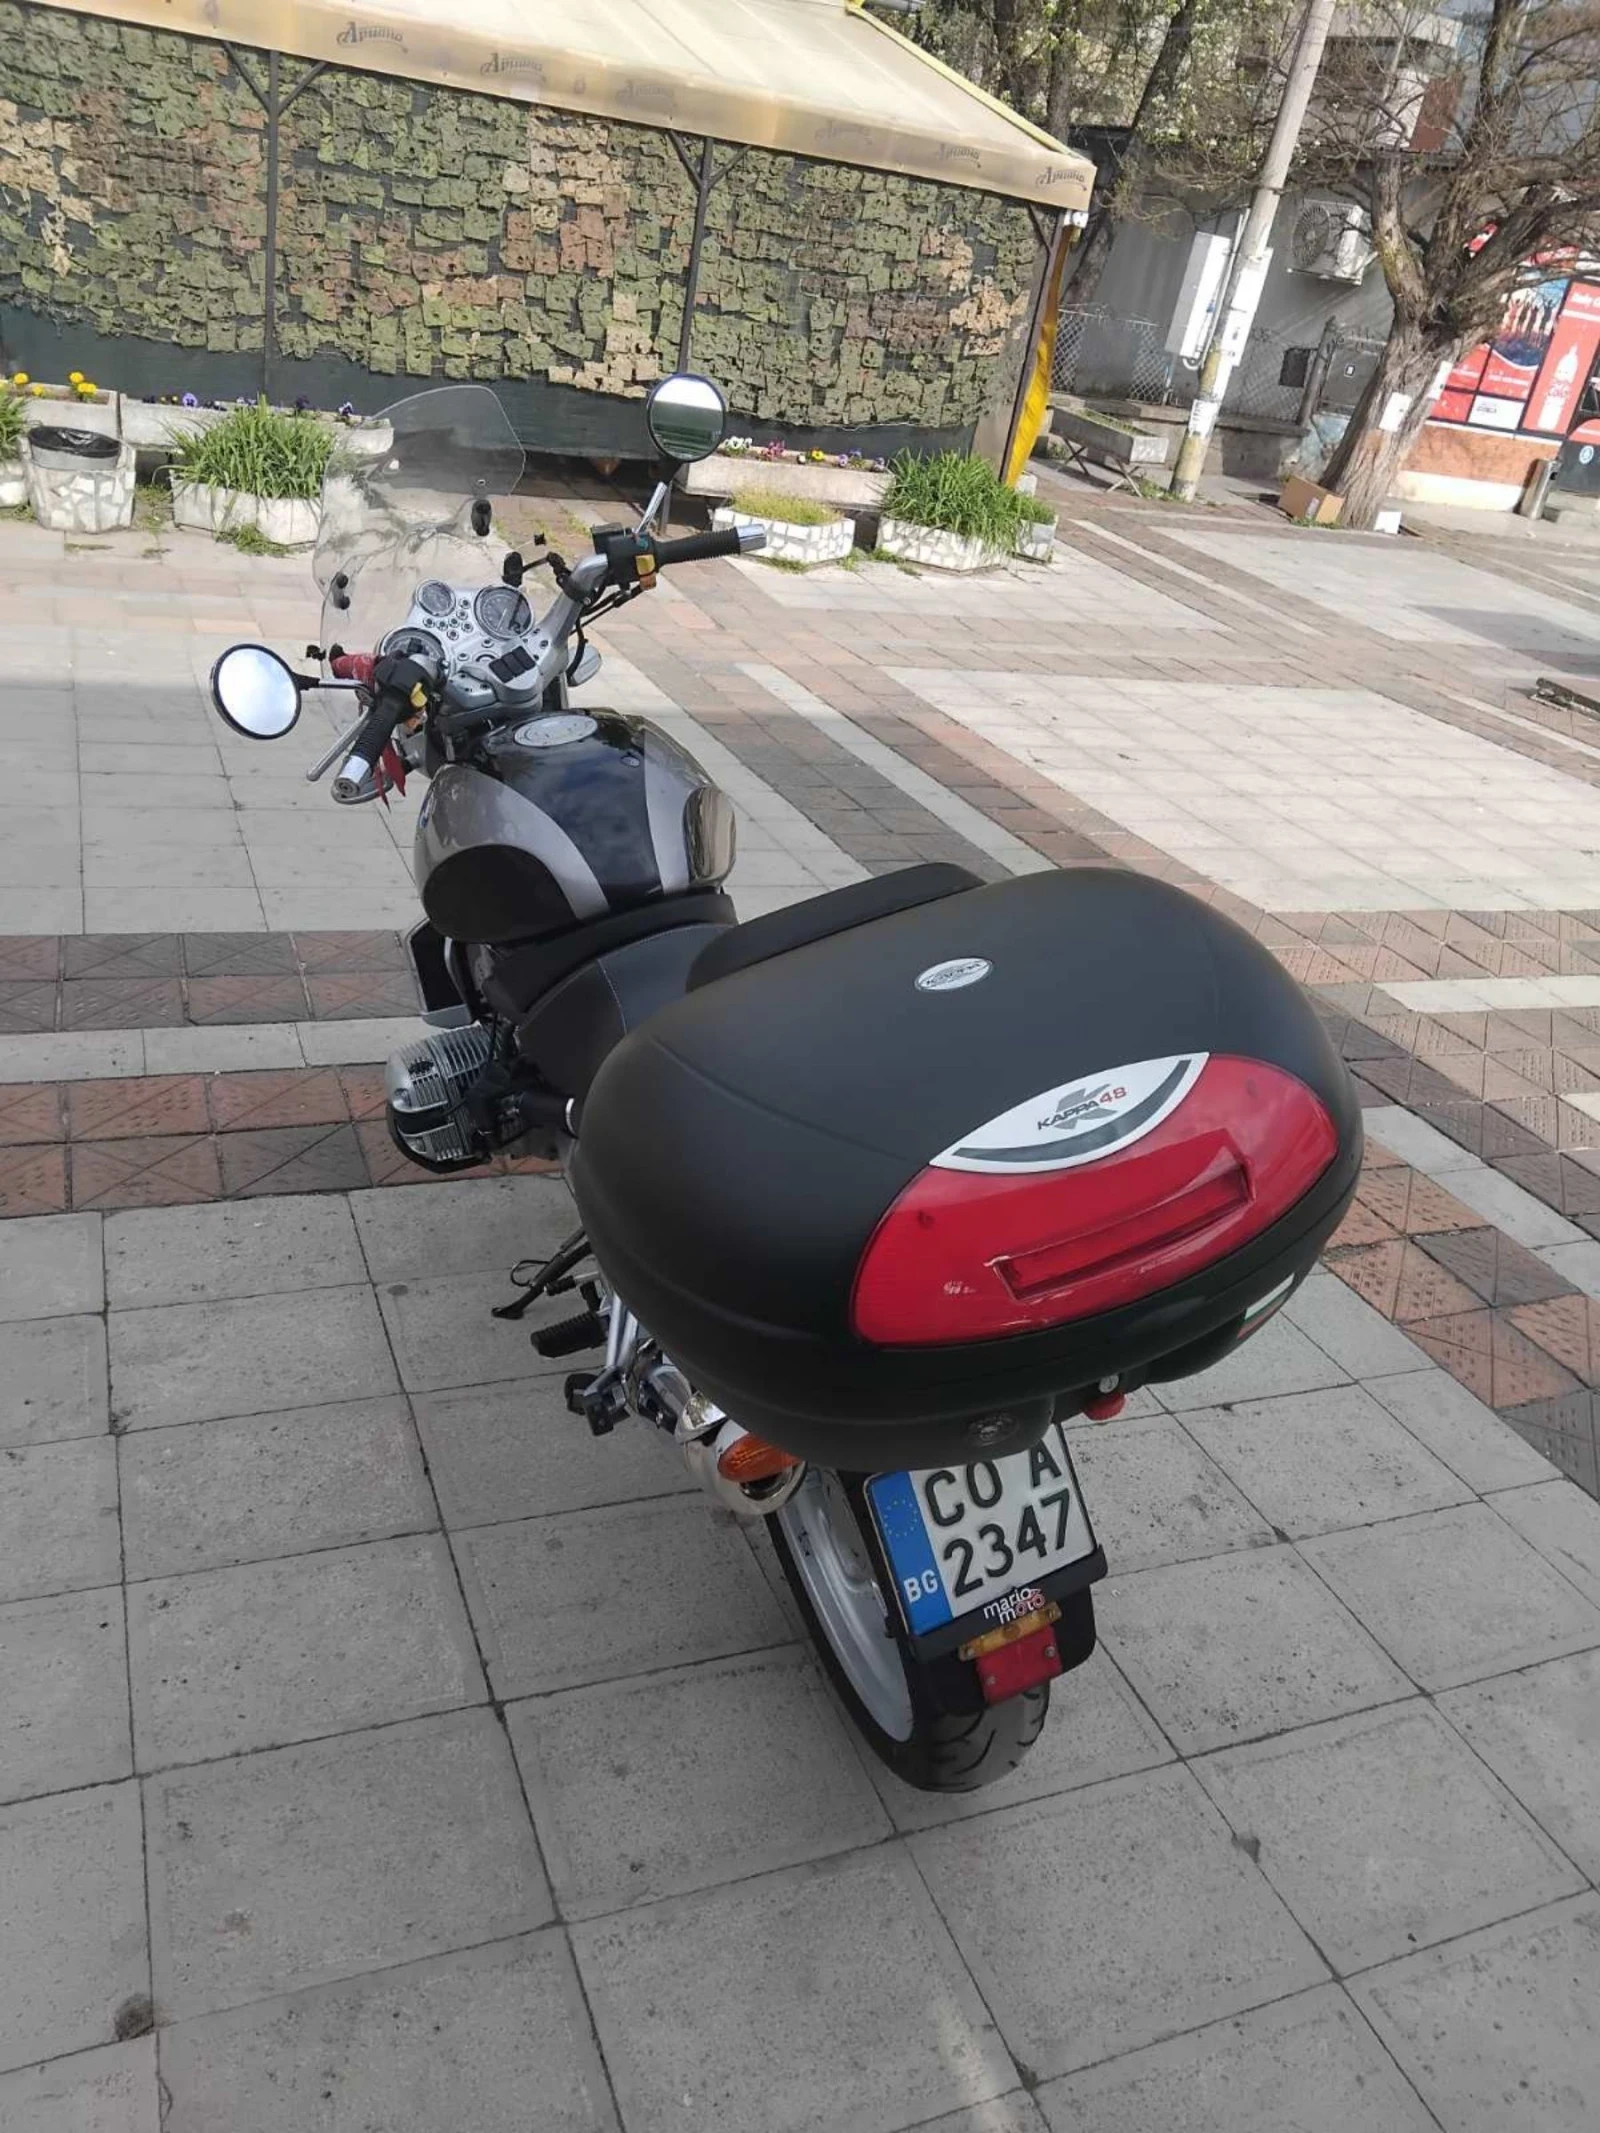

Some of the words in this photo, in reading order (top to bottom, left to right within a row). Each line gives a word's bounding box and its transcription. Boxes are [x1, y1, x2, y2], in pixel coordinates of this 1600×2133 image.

[1037, 1100, 1099, 1130] KAPPA
[1099, 1087, 1127, 1104] 48
[1029, 1439, 1062, 1488] A
[943, 1488, 1070, 1598] 2347
[903, 1569, 938, 1603] BG
[983, 1587, 1031, 1619] mario
[999, 1593, 1045, 1625] moto
